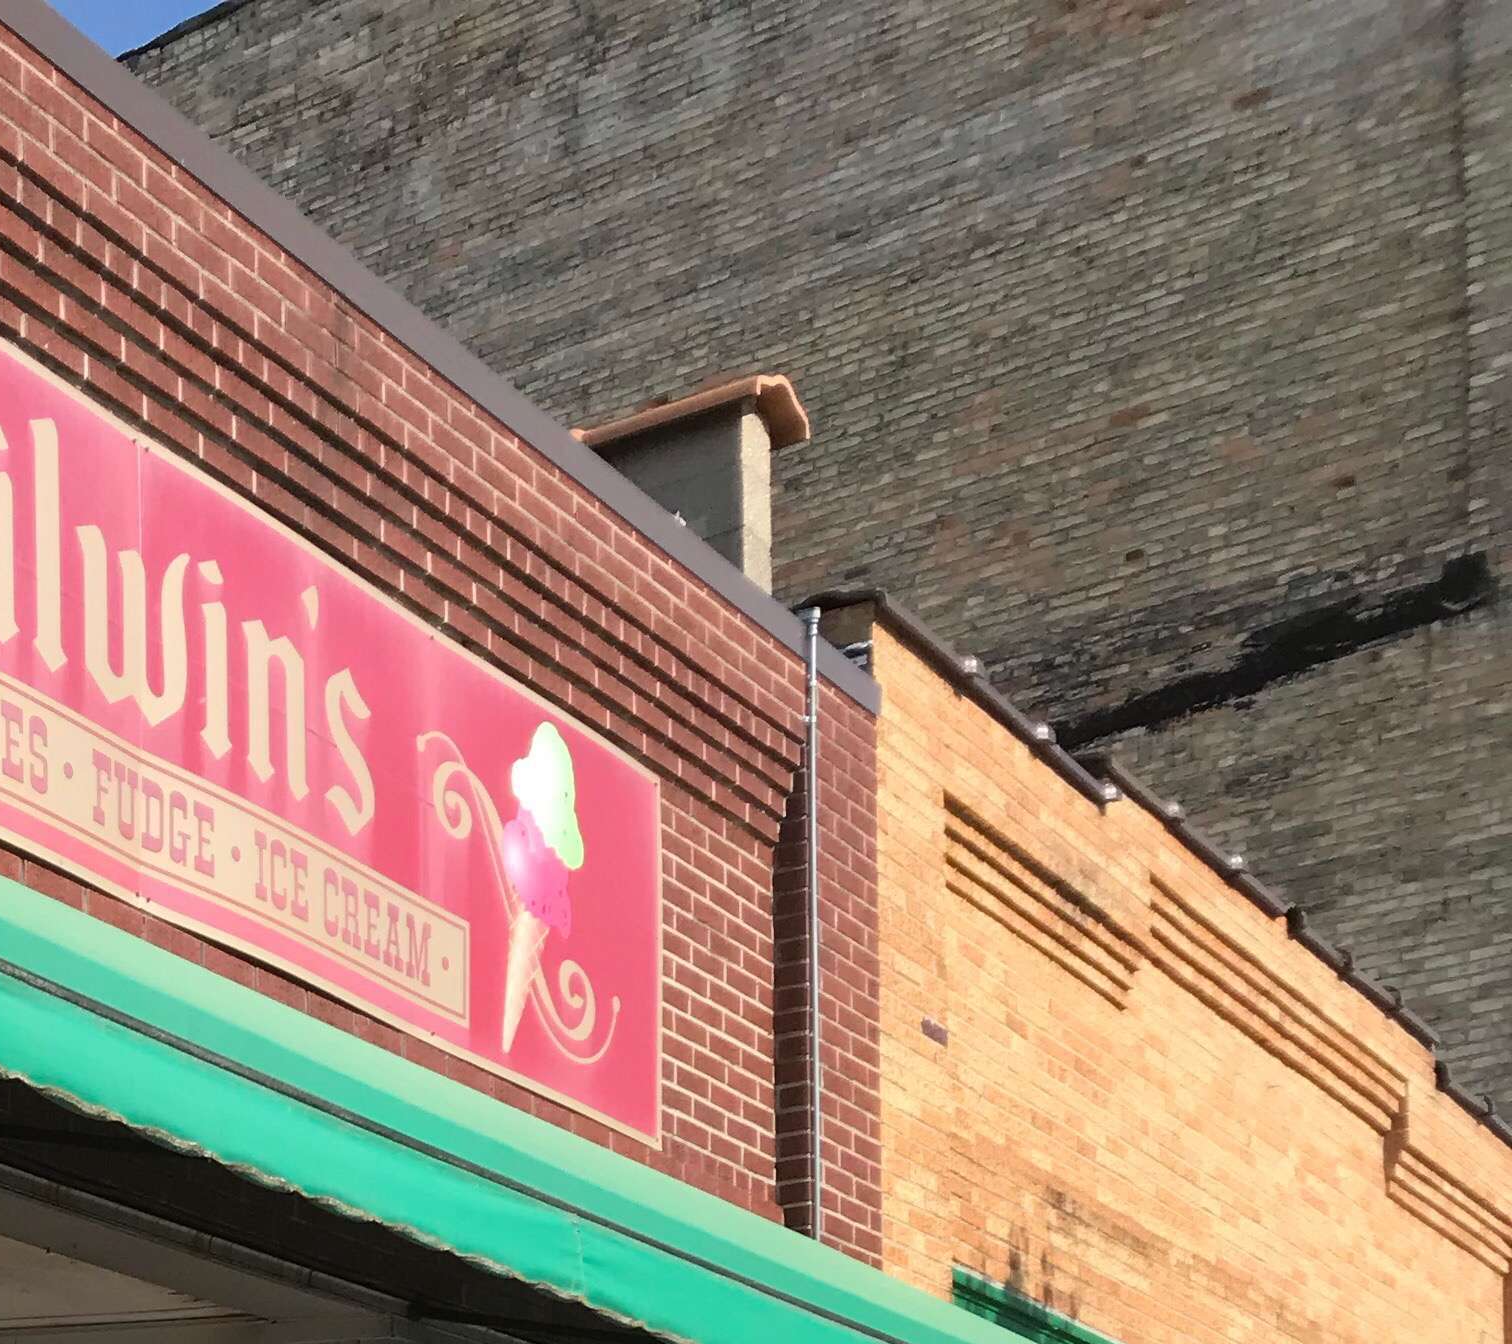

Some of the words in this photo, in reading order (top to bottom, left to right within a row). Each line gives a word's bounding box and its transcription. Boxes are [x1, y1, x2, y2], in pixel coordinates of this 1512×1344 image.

[91, 747, 217, 879] FUDGE
[254, 829, 309, 921] ICE
[322, 868, 432, 988] CREAM
